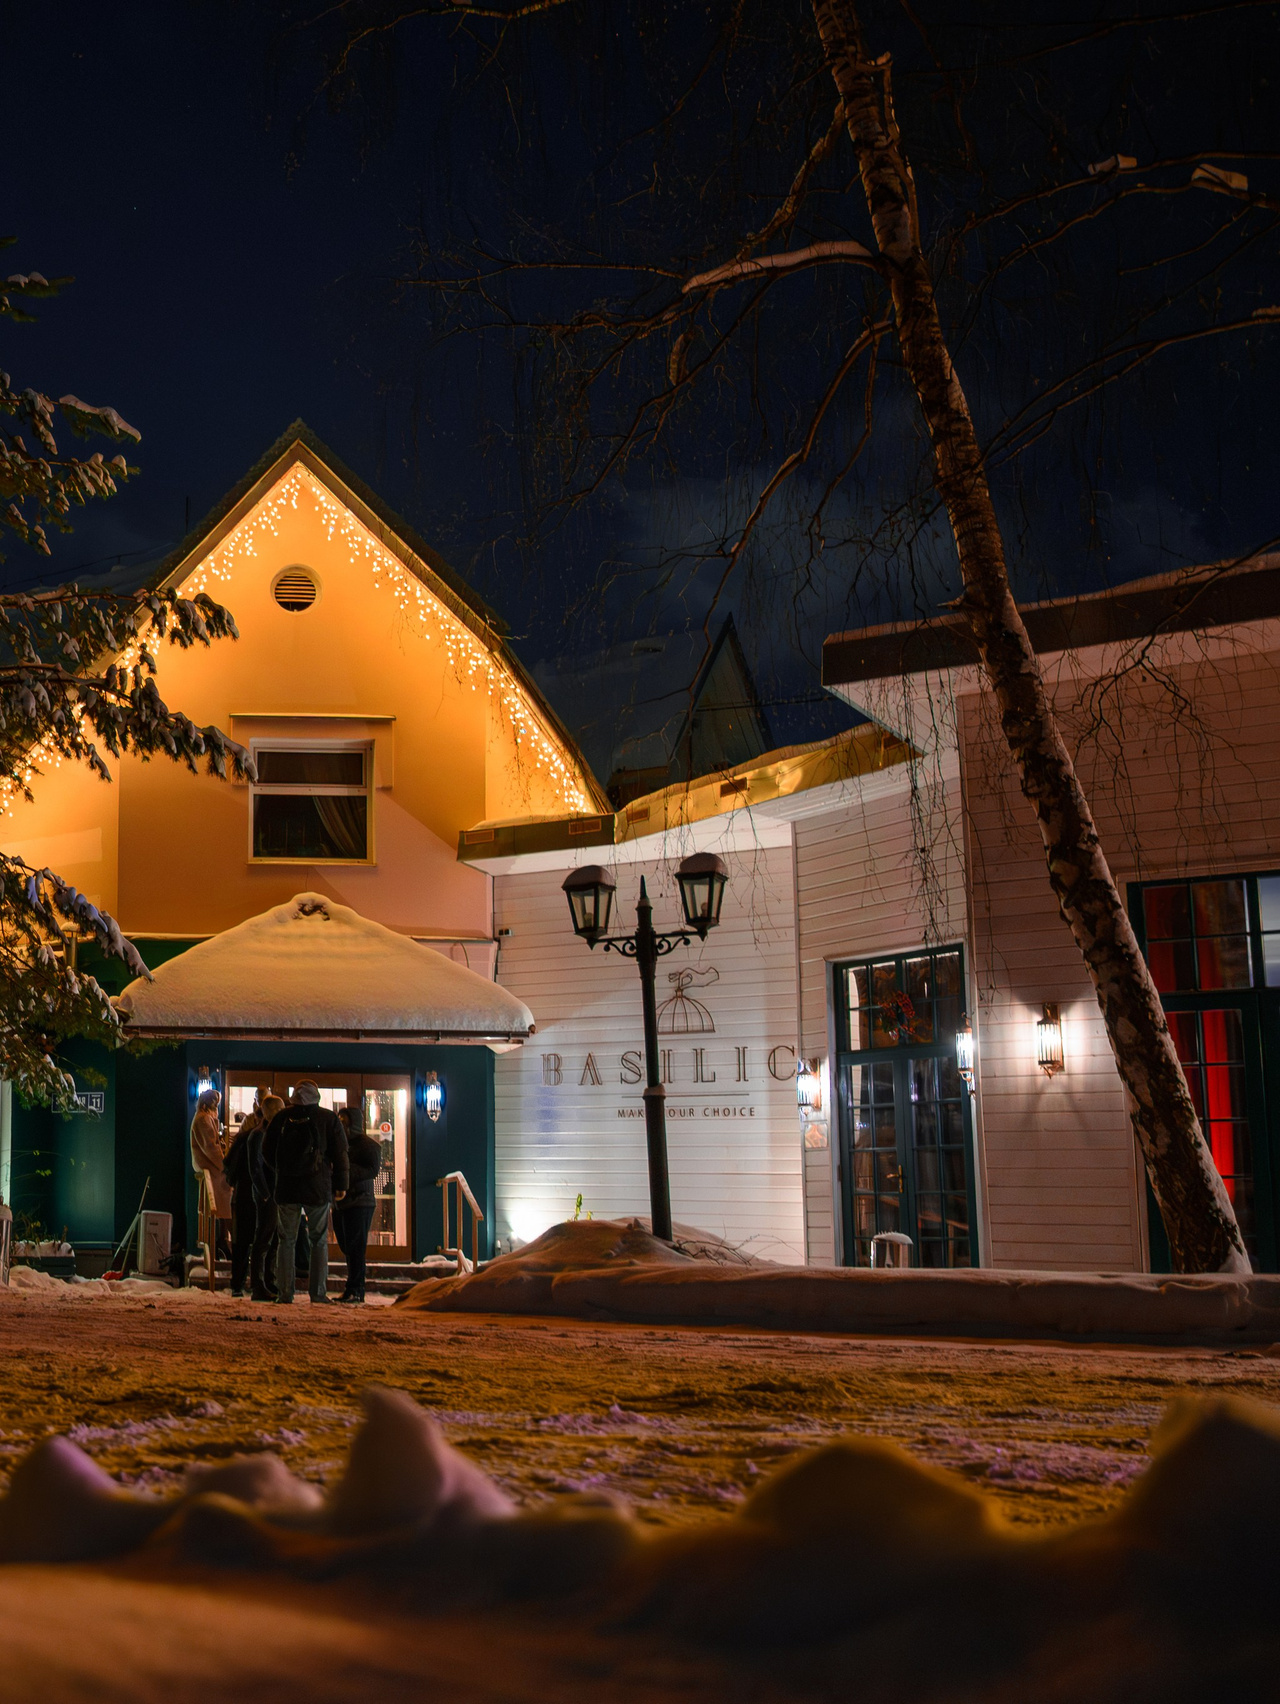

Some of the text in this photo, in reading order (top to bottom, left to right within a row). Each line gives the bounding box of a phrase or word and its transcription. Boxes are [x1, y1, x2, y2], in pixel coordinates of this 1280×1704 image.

[540, 1045, 796, 1086] BASILIC
[92, 1097, 101, 1108] 11
[617, 1107, 756, 1118] MAK OUR CHOICE
